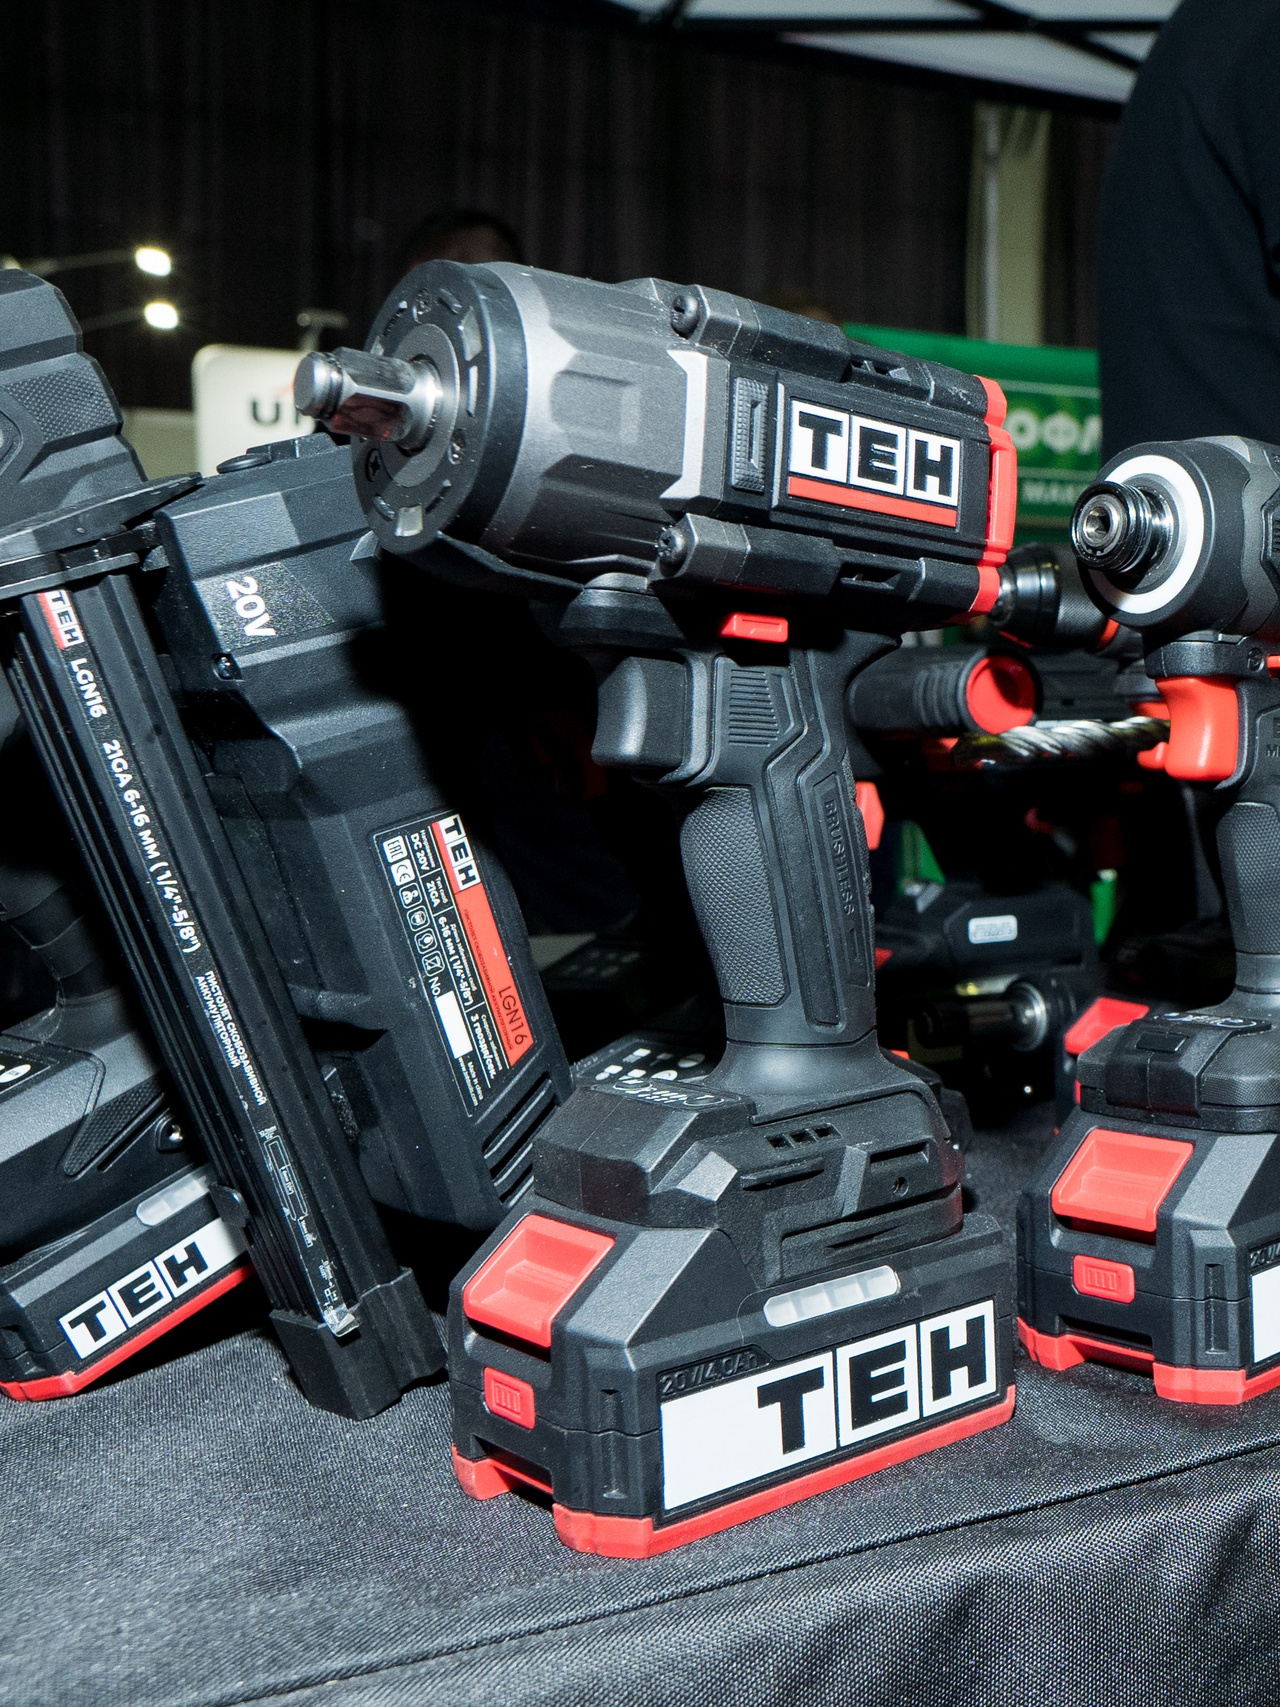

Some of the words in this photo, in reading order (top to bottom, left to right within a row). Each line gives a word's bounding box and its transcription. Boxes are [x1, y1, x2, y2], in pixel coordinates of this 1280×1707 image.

[796, 408, 957, 500] TEH
[49, 591, 80, 644] TEH
[226, 576, 277, 637] 20V
[70, 658, 107, 719] LGN16
[103, 739, 136, 788] 21GA
[124, 789, 150, 827] 6-16
[410, 832, 423, 851] DC
[415, 849, 431, 871] 20V
[441, 817, 477, 885] TEH
[426, 880, 441, 908] 21GA
[205, 971, 232, 1020] ПИСТОЛЕТ
[470, 1012, 480, 1023] 3
[499, 986, 528, 1046] LGN16
[67, 1241, 209, 1345] TEH
[755, 1315, 989, 1456] TEH
